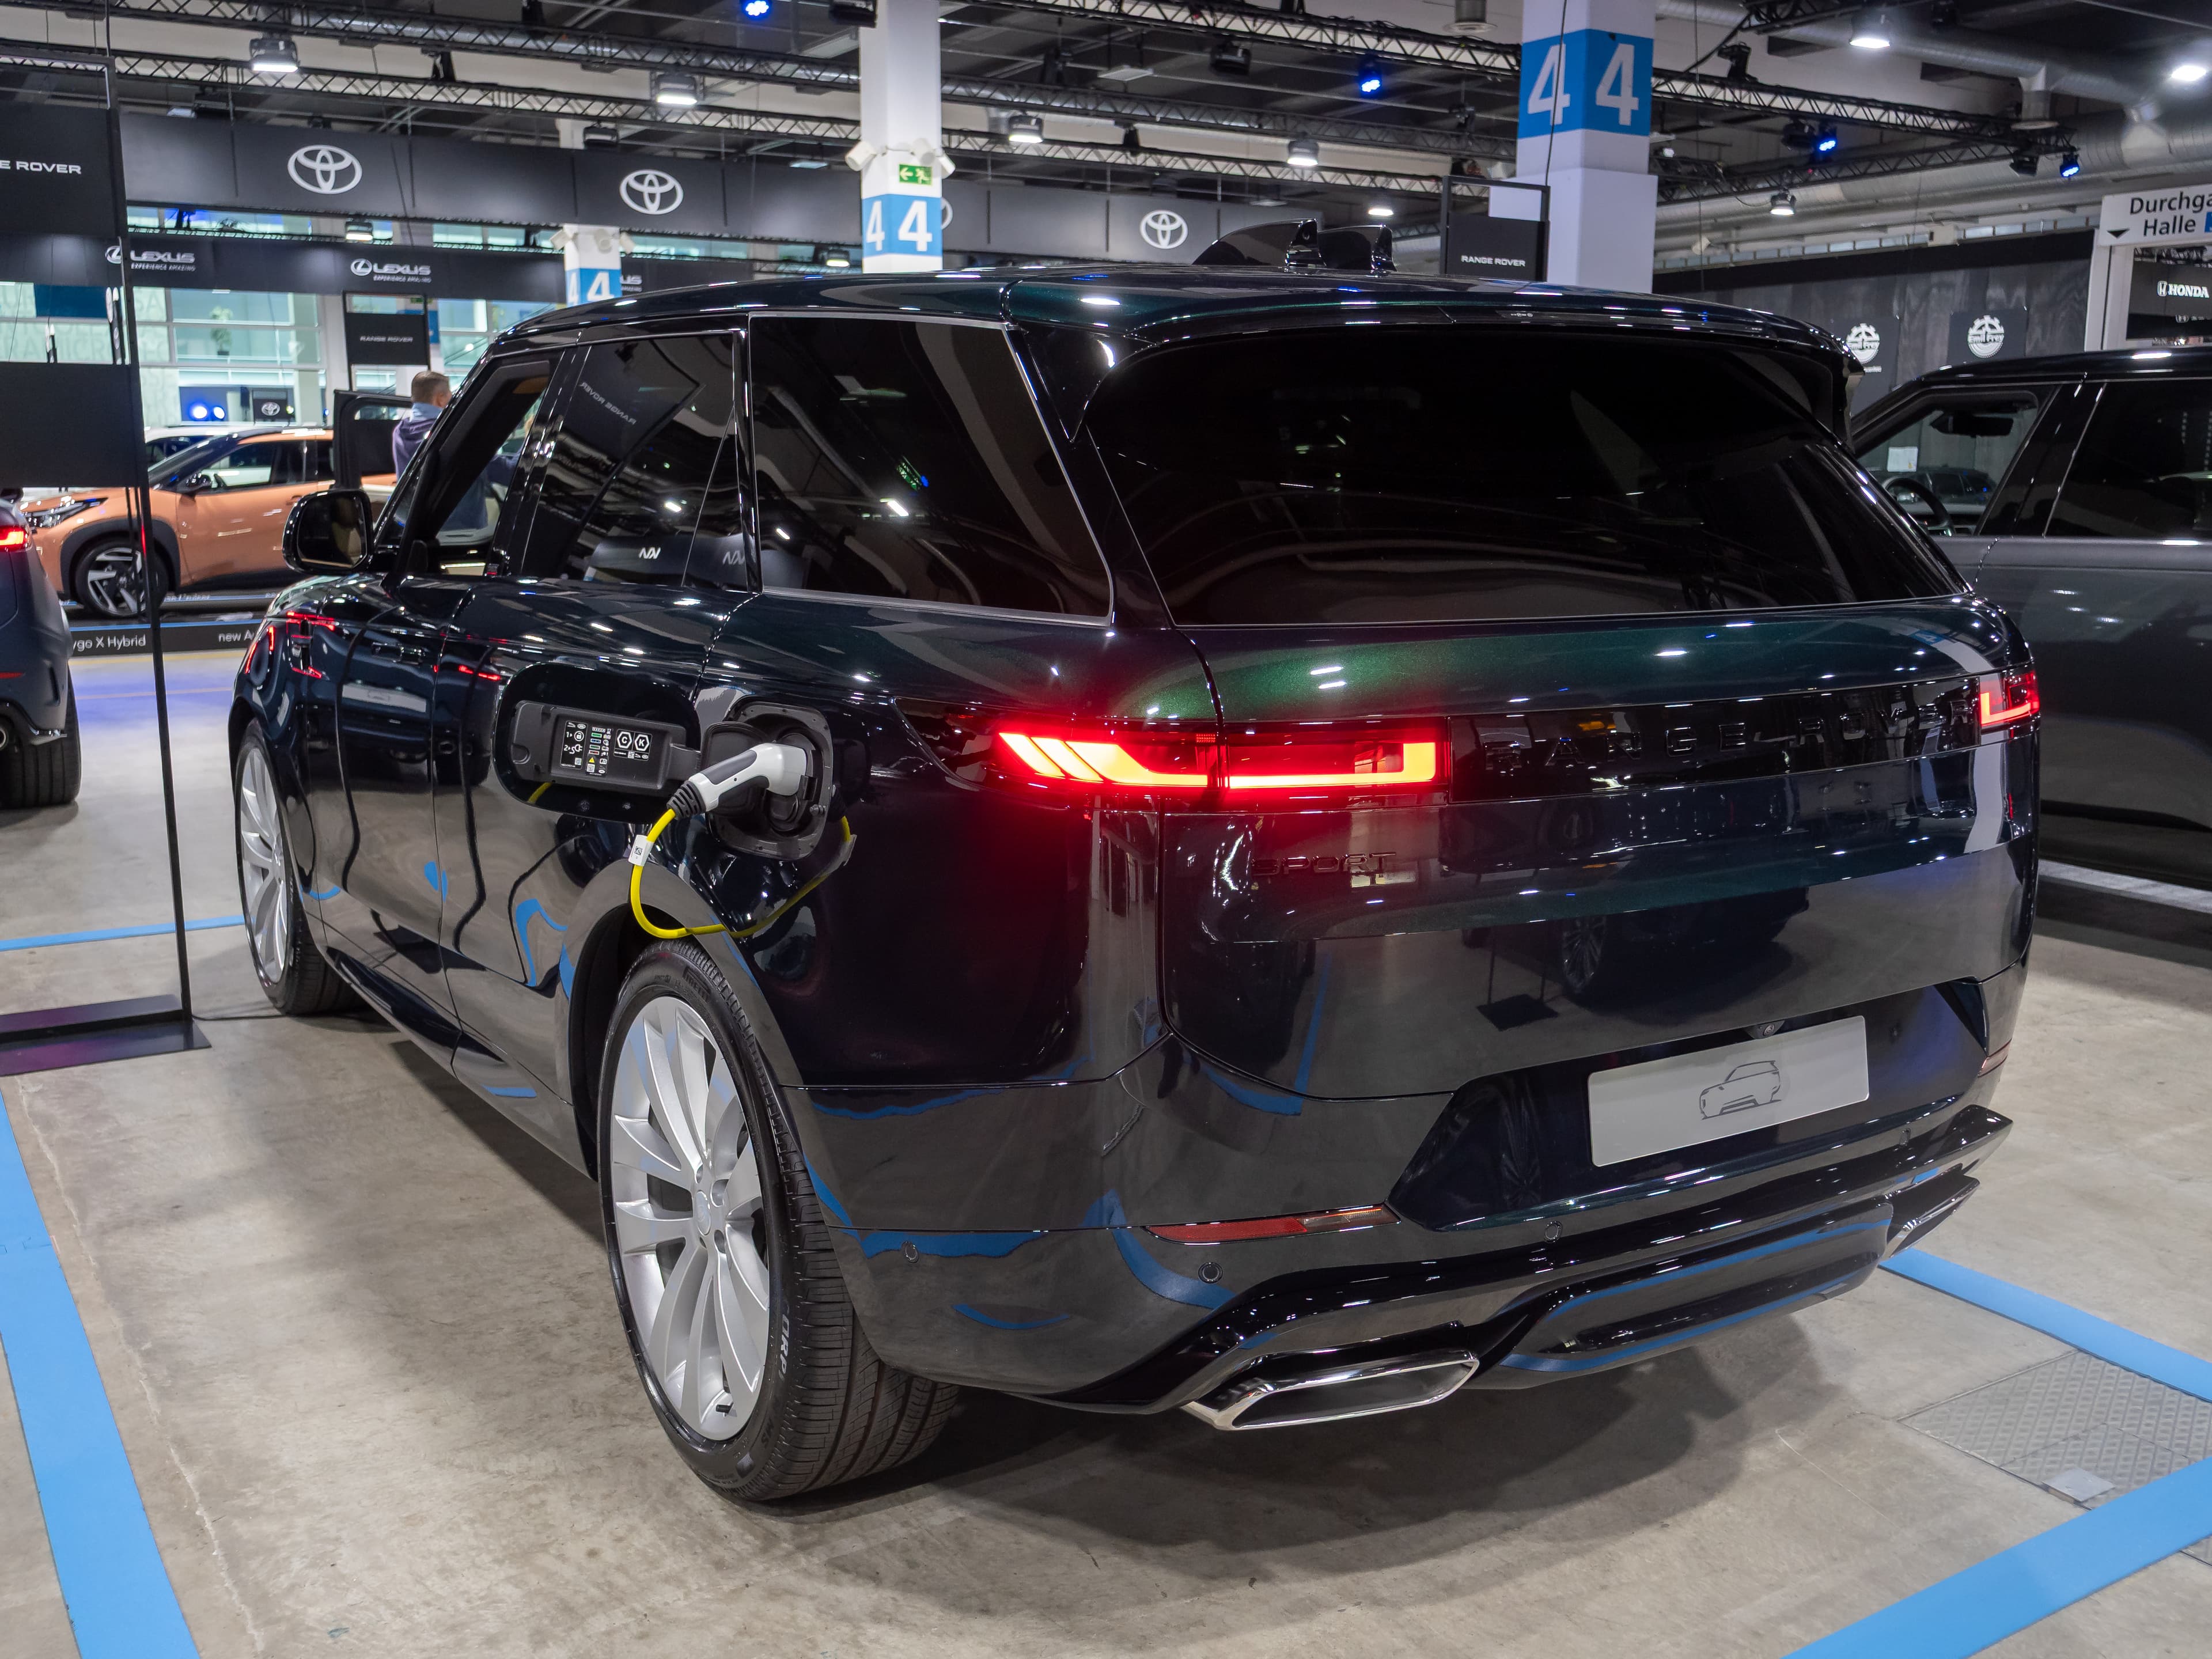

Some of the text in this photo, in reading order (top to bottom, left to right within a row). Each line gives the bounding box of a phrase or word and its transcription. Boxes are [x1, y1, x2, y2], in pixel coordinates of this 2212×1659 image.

[1528, 43, 1570, 126] 4
[1596, 43, 1639, 126] 4
[16, 161, 81, 175] ROVER
[866, 200, 885, 251] 4
[899, 200, 933, 252] 4
[2143, 215, 2196, 237] Halle
[130, 250, 195, 263] LEXUS
[1461, 255, 1525, 267] RANGE ROVER
[373, 263, 431, 275] LEXUS
[567, 272, 578, 305] 4
[586, 271, 614, 301] 4
[2168, 283, 2210, 298] HONDA
[96, 636, 104, 648] X
[107, 634, 146, 650] Hybrid
[218, 632, 241, 642] new
[638, 738, 645, 747] K
[1484, 699, 1969, 771] RANGE ROVER
[1252, 851, 1397, 876] SPORT
